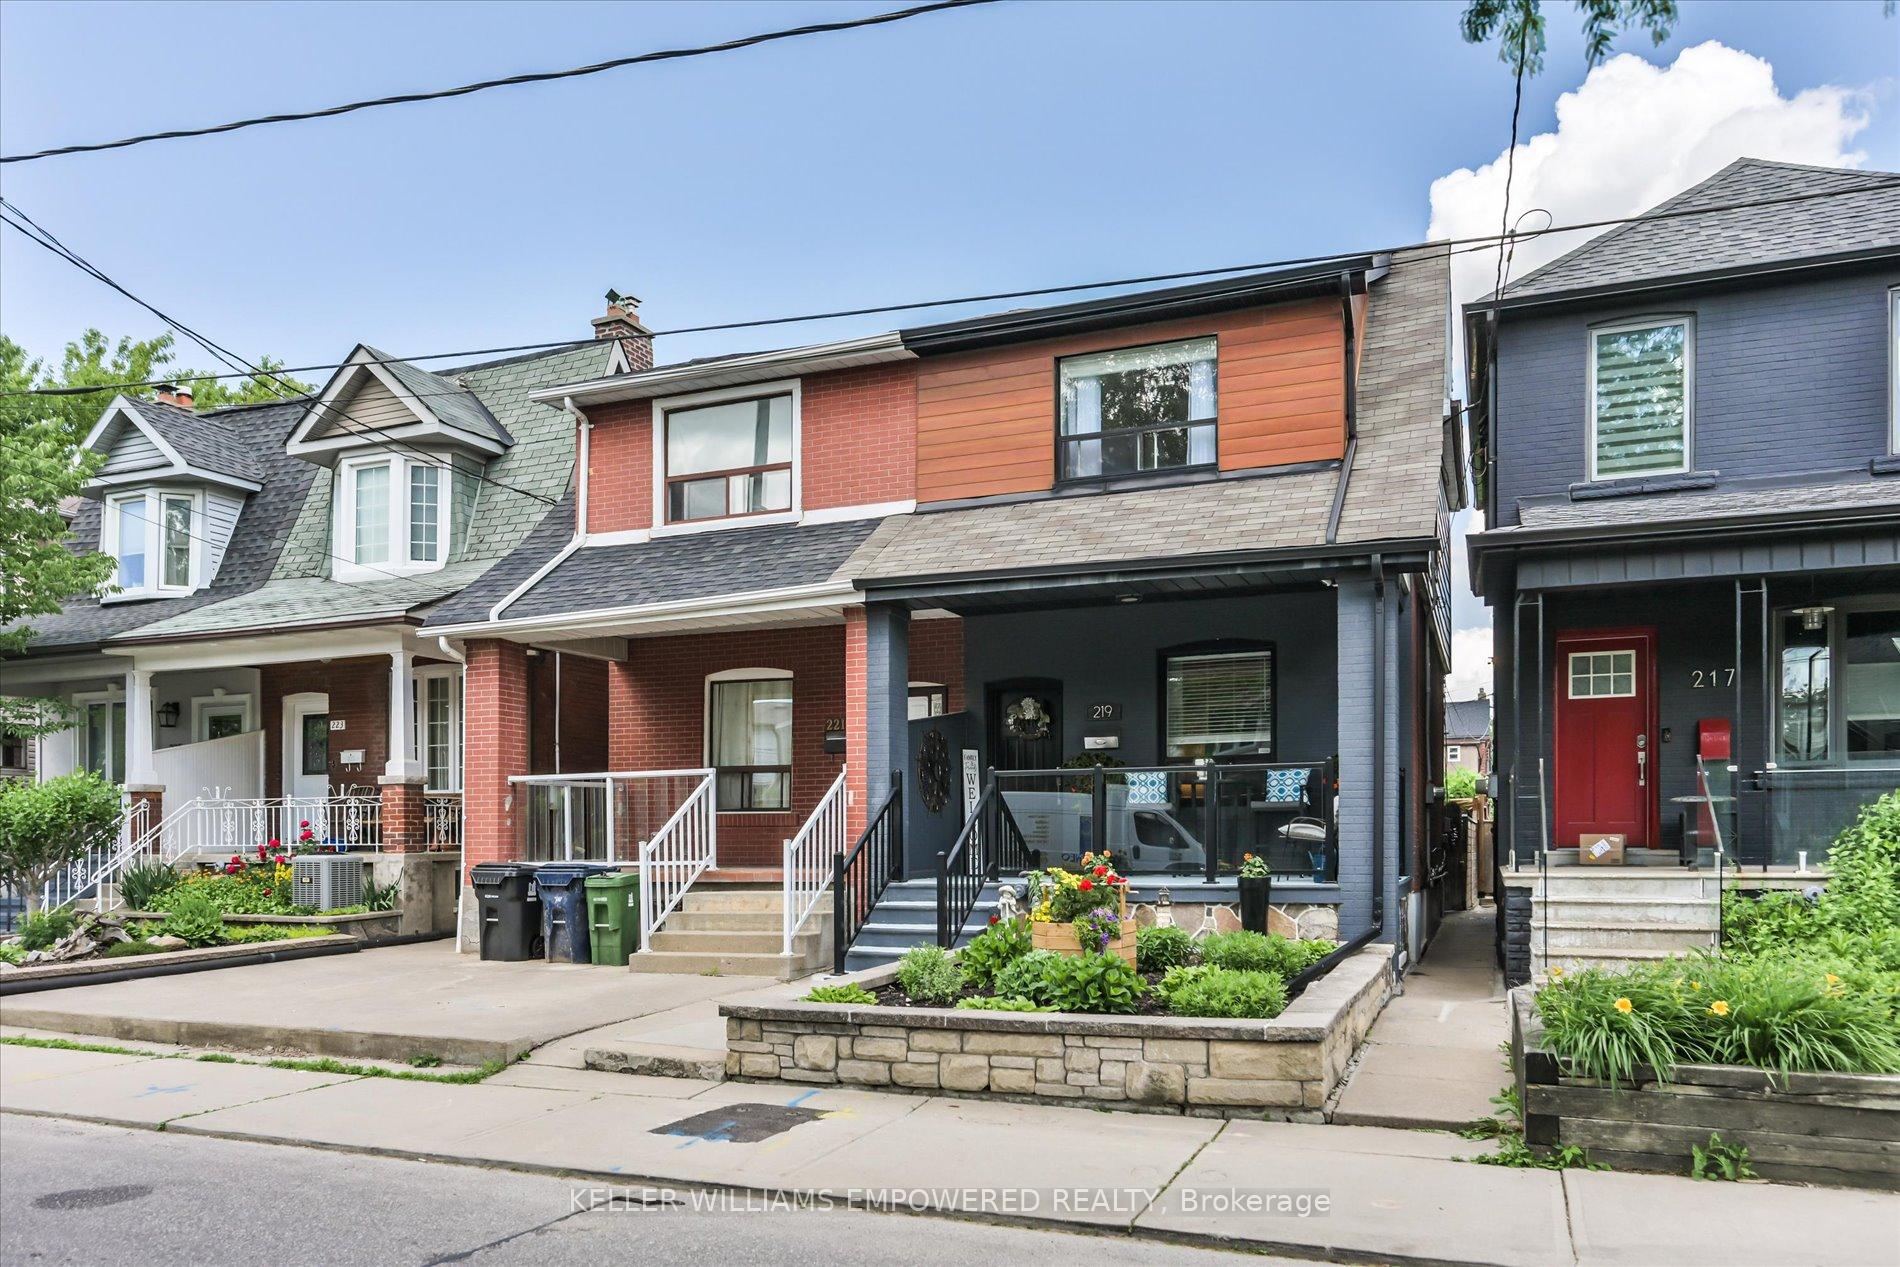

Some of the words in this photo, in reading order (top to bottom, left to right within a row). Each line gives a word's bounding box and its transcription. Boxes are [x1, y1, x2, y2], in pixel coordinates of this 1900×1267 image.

[1691, 668, 1735, 688] 217
[1093, 705, 1113, 719] 219
[331, 720, 344, 729] 223
[826, 719, 845, 730] 221
